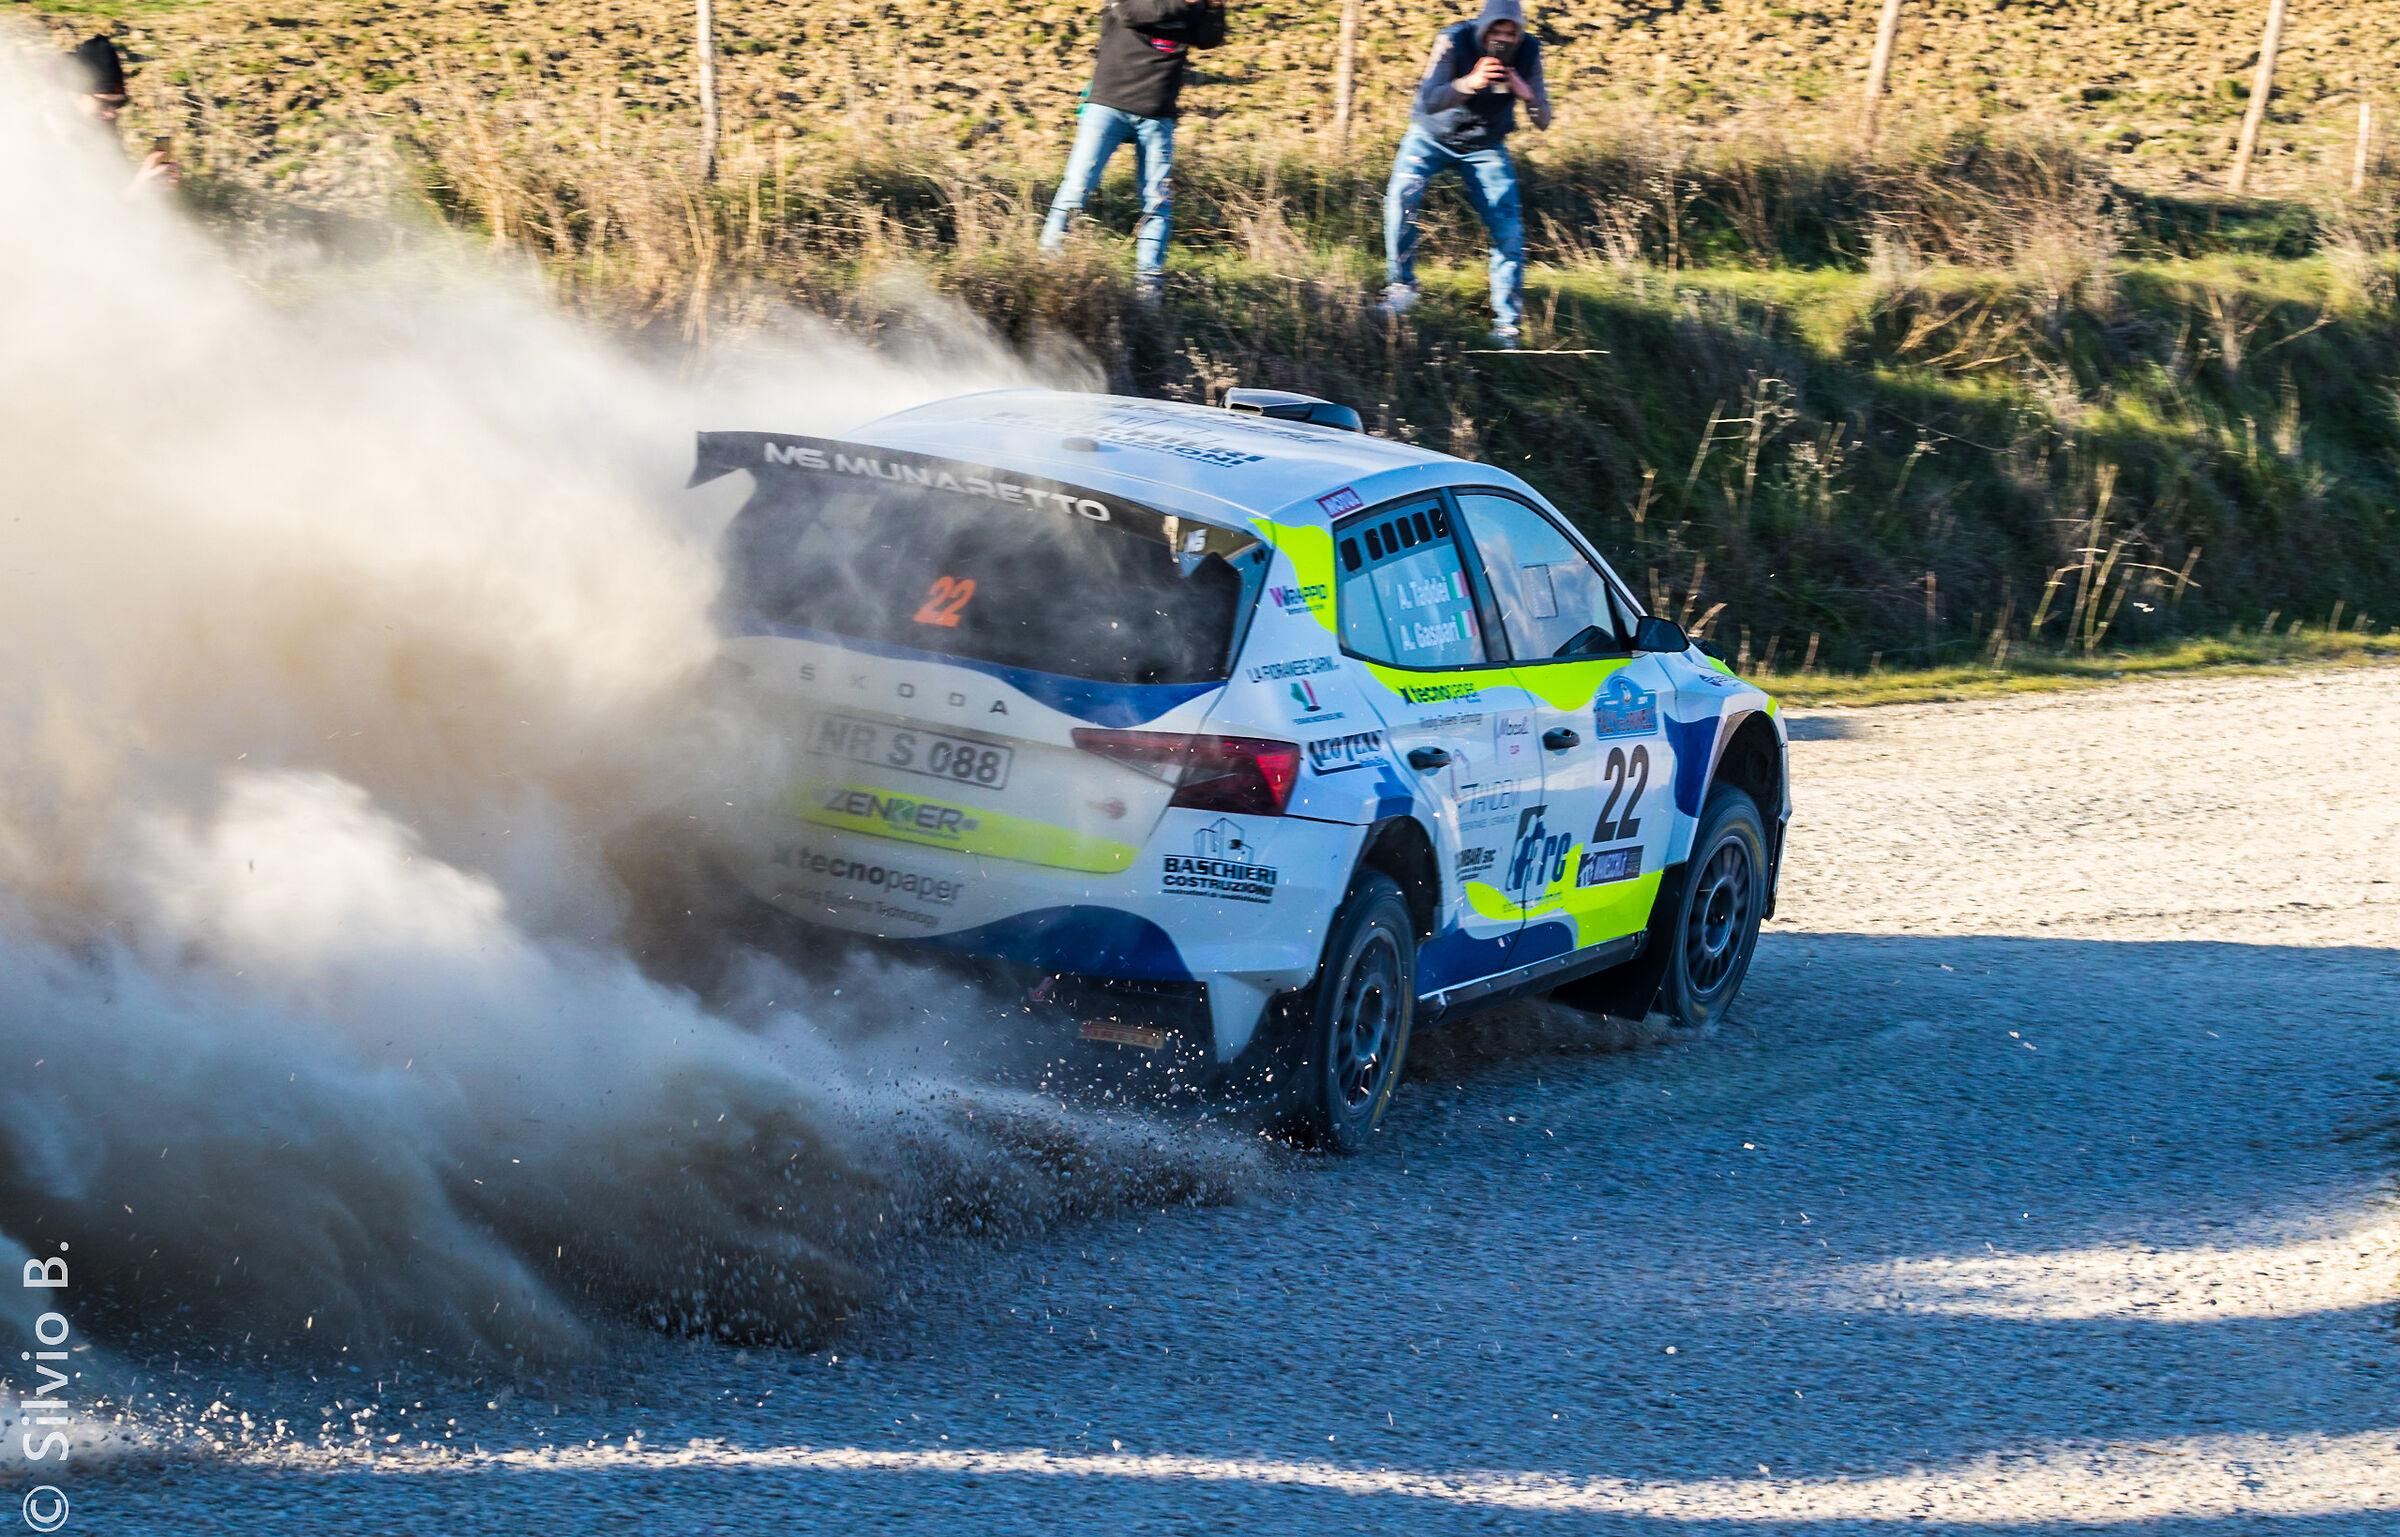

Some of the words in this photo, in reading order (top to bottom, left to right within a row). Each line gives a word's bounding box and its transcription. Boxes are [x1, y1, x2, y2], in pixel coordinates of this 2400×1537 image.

[764, 441, 830, 470] MS
[835, 453, 1111, 522] MUNARETTO
[914, 576, 977, 627] 22
[1397, 583, 1414, 610] A.
[1400, 624, 1417, 651] A.
[887, 732, 917, 767] S
[927, 741, 1001, 784] 088
[823, 789, 964, 833] ZENKER
[1592, 744, 1650, 843] 22
[798, 848, 965, 902] tecnopaper
[1162, 875, 1274, 897] COSTRUZIONI
[1164, 857, 1278, 885] BASCHIERI
